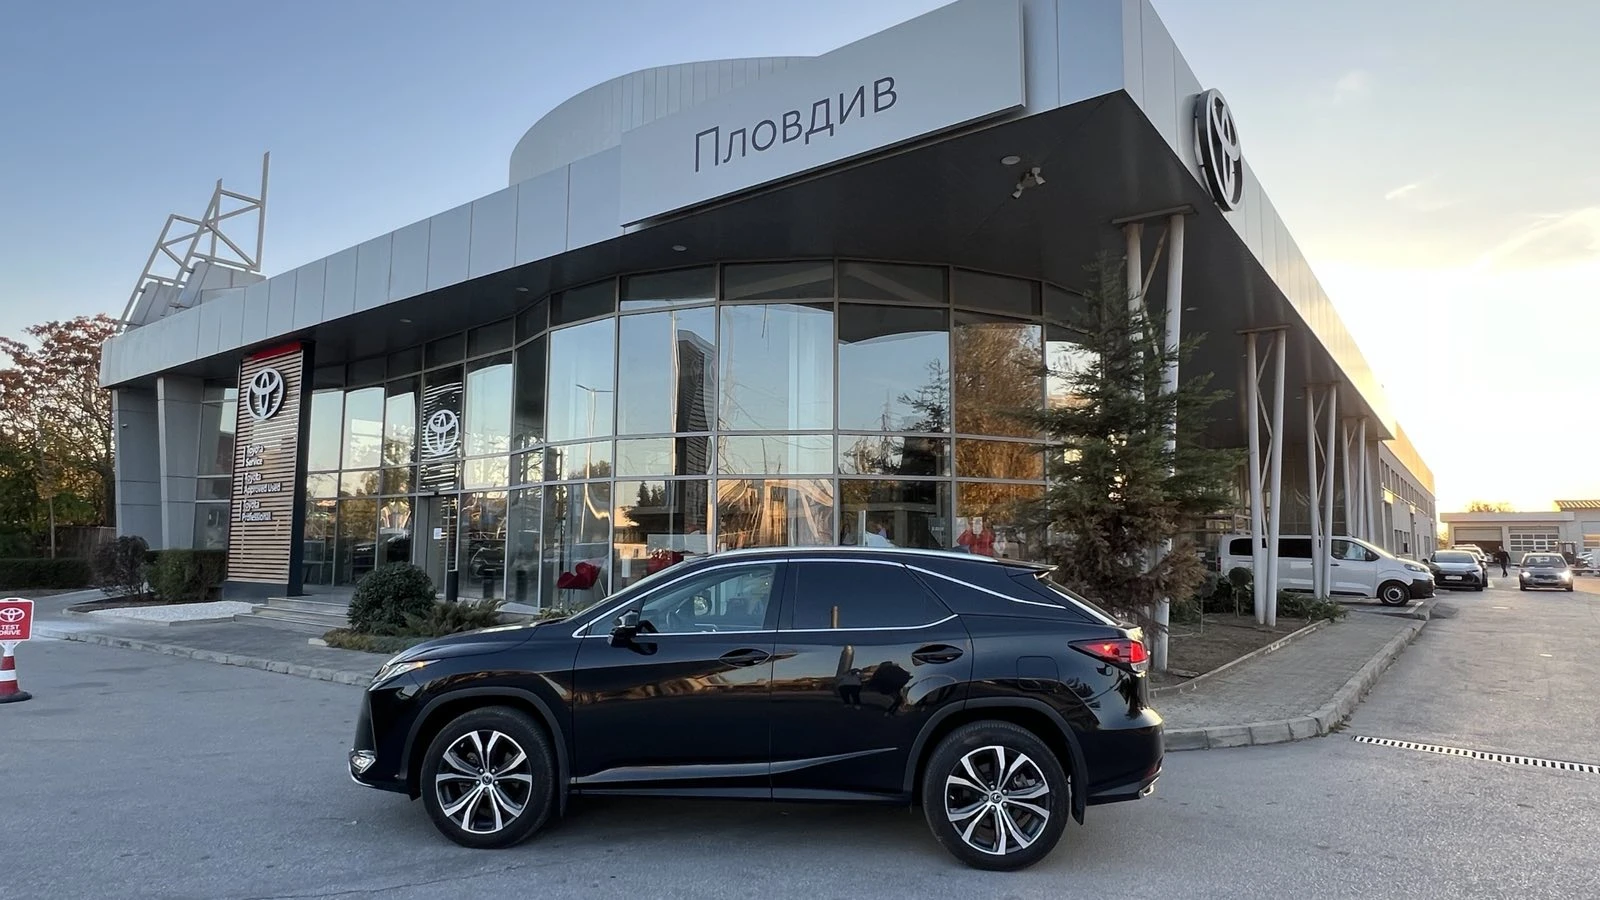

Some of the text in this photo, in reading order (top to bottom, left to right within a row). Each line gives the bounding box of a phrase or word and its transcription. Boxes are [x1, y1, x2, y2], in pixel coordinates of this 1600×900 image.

[695, 76, 898, 173] Пловдив
[246, 445, 264, 457] Toyota
[245, 457, 263, 467] Service
[244, 473, 262, 484] Toyota
[243, 483, 281, 495] Approved Used
[243, 500, 260, 512] Toyota
[241, 512, 272, 521] Professional
